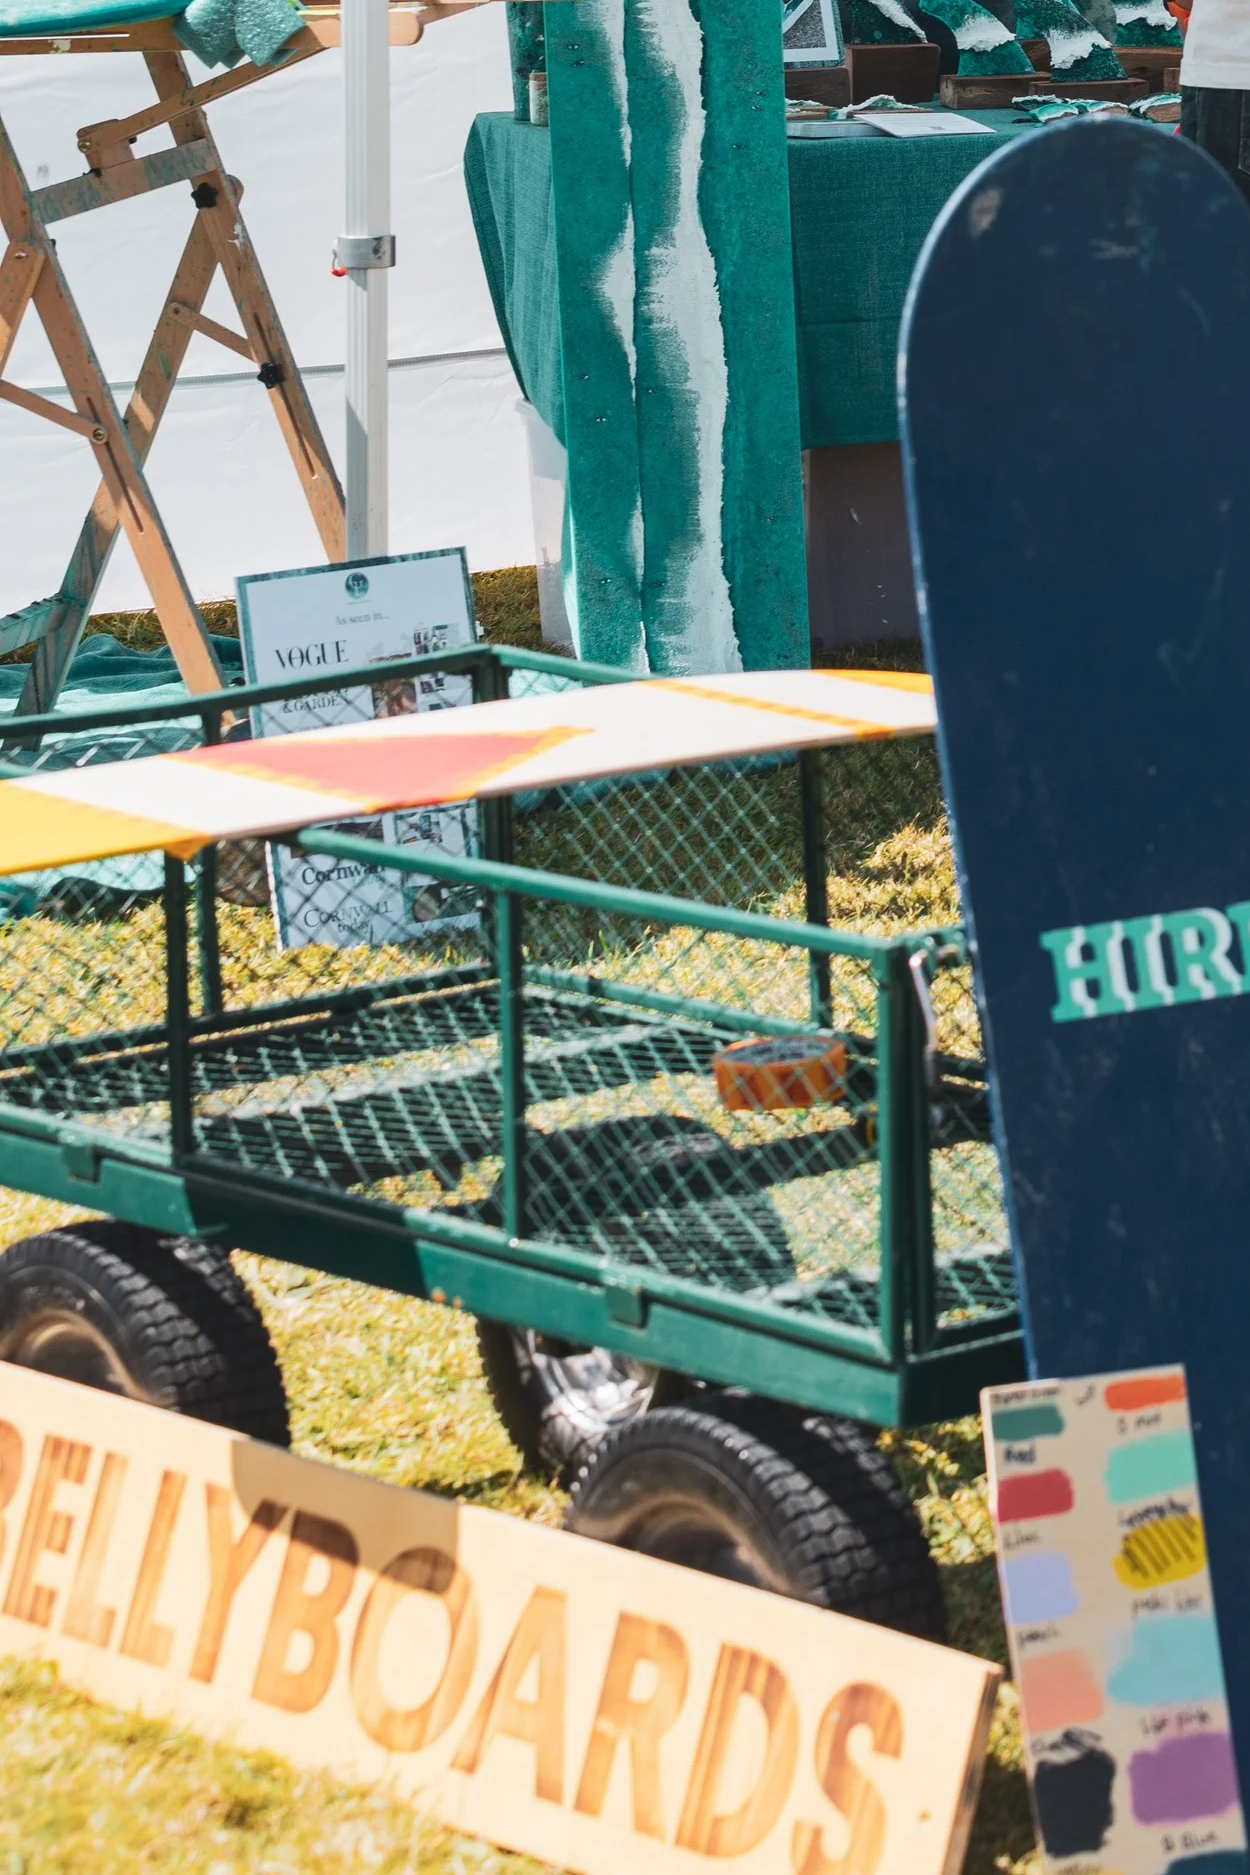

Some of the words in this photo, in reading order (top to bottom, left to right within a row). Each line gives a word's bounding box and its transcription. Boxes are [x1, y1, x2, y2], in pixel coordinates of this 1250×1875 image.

[336, 615, 347, 626] As
[348, 612, 371, 624] seen
[274, 639, 349, 670] VOGUE
[0, 1419, 903, 1875] ELLYBOARDS
